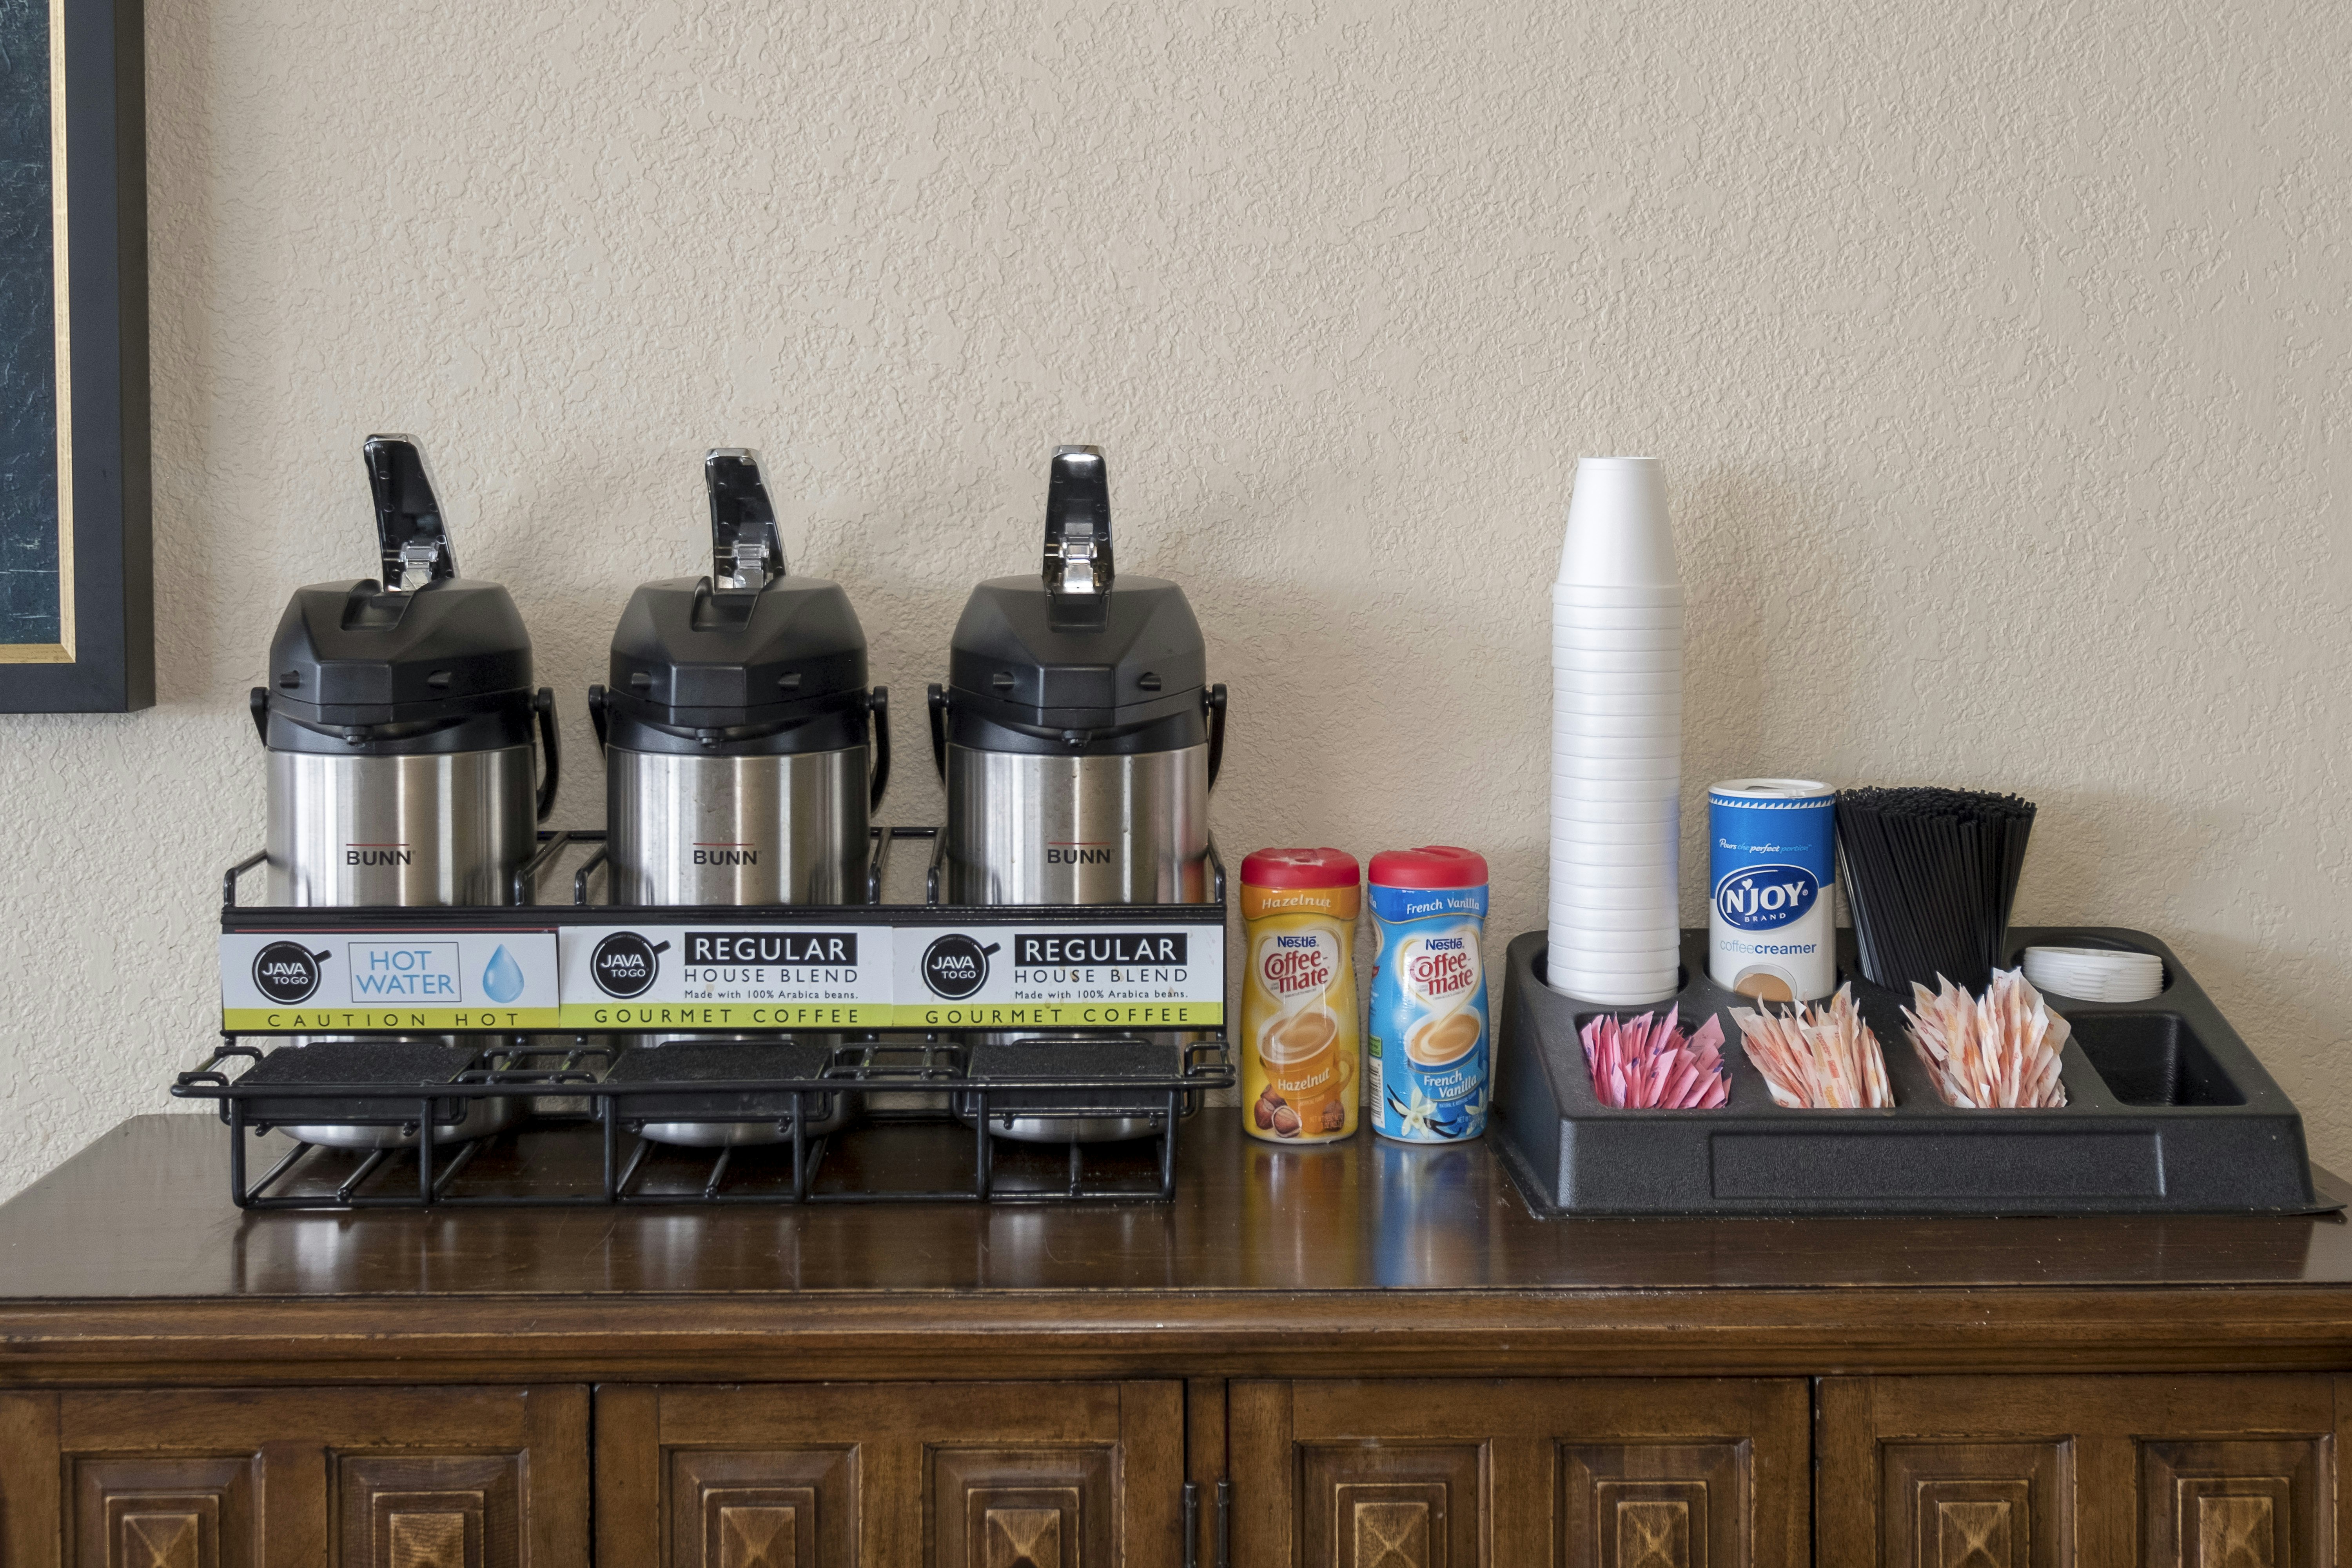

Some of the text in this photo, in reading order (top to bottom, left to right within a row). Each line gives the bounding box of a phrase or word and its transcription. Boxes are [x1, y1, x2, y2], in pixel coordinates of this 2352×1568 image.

[1719, 838, 1736, 850] Pours
[1749, 843, 1780, 854] perfect
[347, 850, 412, 866] BUNN
[693, 850, 757, 866] BUNN
[1047, 849, 1111, 864] BUNN
[1262, 894, 1332, 909] Hazelnut
[1406, 898, 1480, 915] French Vanilla
[1745, 913, 1786, 922] BRAND
[696, 938, 846, 960] REGULAR
[1026, 939, 1176, 961] REGULAR
[262, 963, 307, 975] JAVA
[370, 951, 432, 971] HOT
[601, 954, 644, 968] JAVA
[932, 956, 975, 970] JAVA
[356, 974, 455, 994] WATER
[685, 969, 857, 983] HOUSE BLEND
[1015, 969, 1187, 983] HOUSE BLEND
[1279, 967, 1328, 993] mate
[1428, 968, 1474, 996] mate
[685, 990, 858, 999] Made with 100% Arabica beans.
[1015, 990, 1188, 999] Made with 100% Arabica beans.
[268, 1013, 518, 1027] CAUTION HOT
[594, 1009, 857, 1023] GOURMET COFFEE
[926, 1008, 1187, 1024] GOURMET COFFEE
[1278, 1067, 1330, 1092] Hazelnut
[1423, 1071, 1463, 1087] French
[1439, 1075, 1477, 1099] Vanilla
